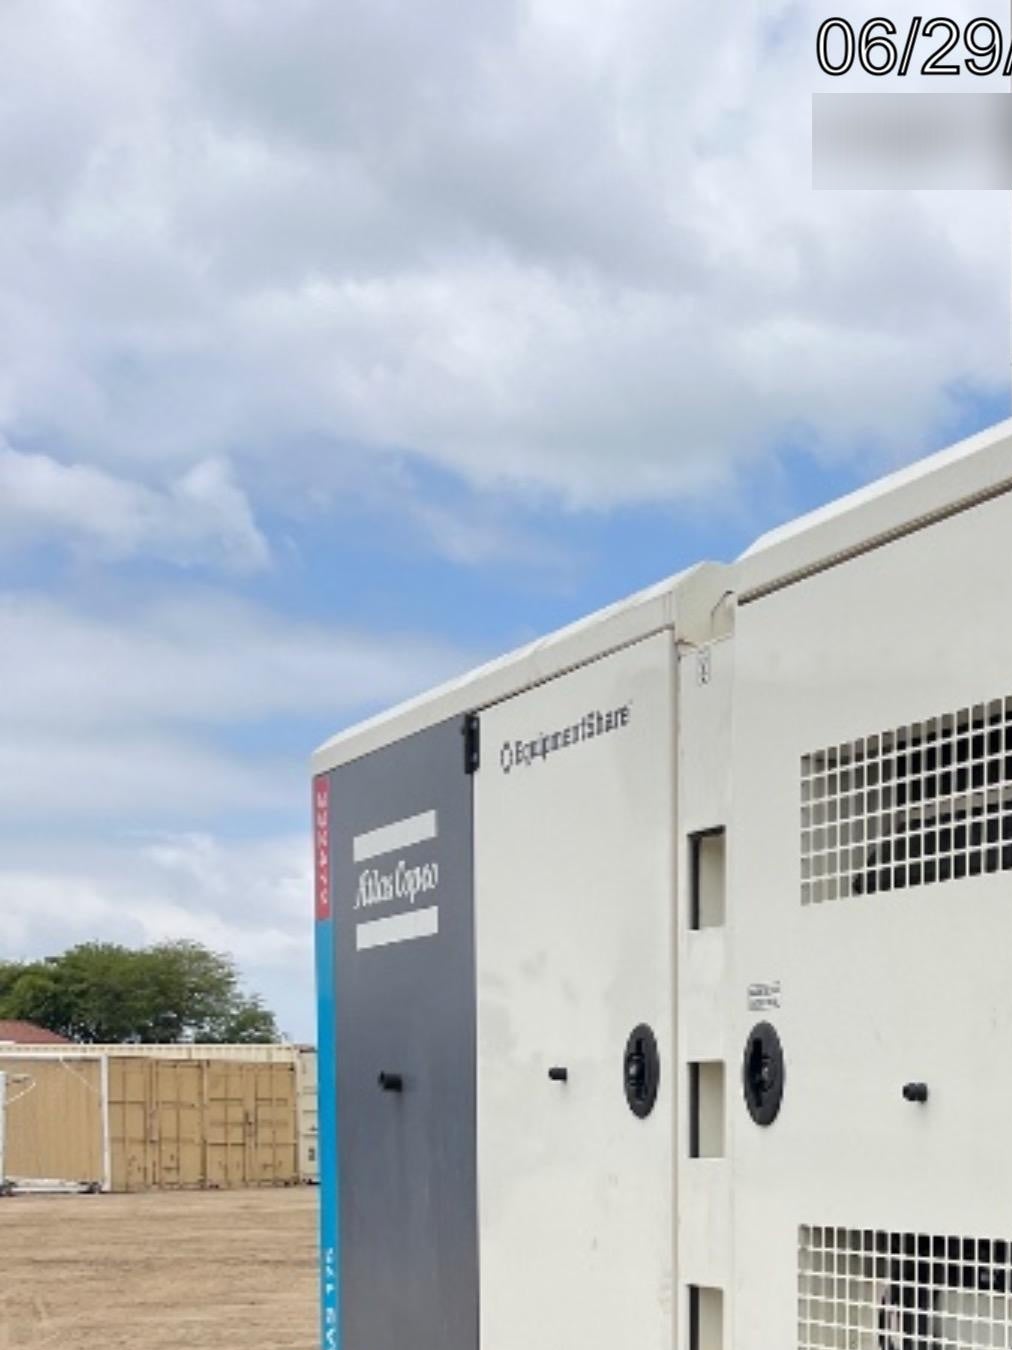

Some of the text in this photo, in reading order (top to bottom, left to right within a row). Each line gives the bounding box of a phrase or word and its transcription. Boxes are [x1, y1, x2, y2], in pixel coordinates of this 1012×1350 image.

[515, 704, 631, 766] EquipmentShare
[353, 860, 439, 910] Atlas Copco
